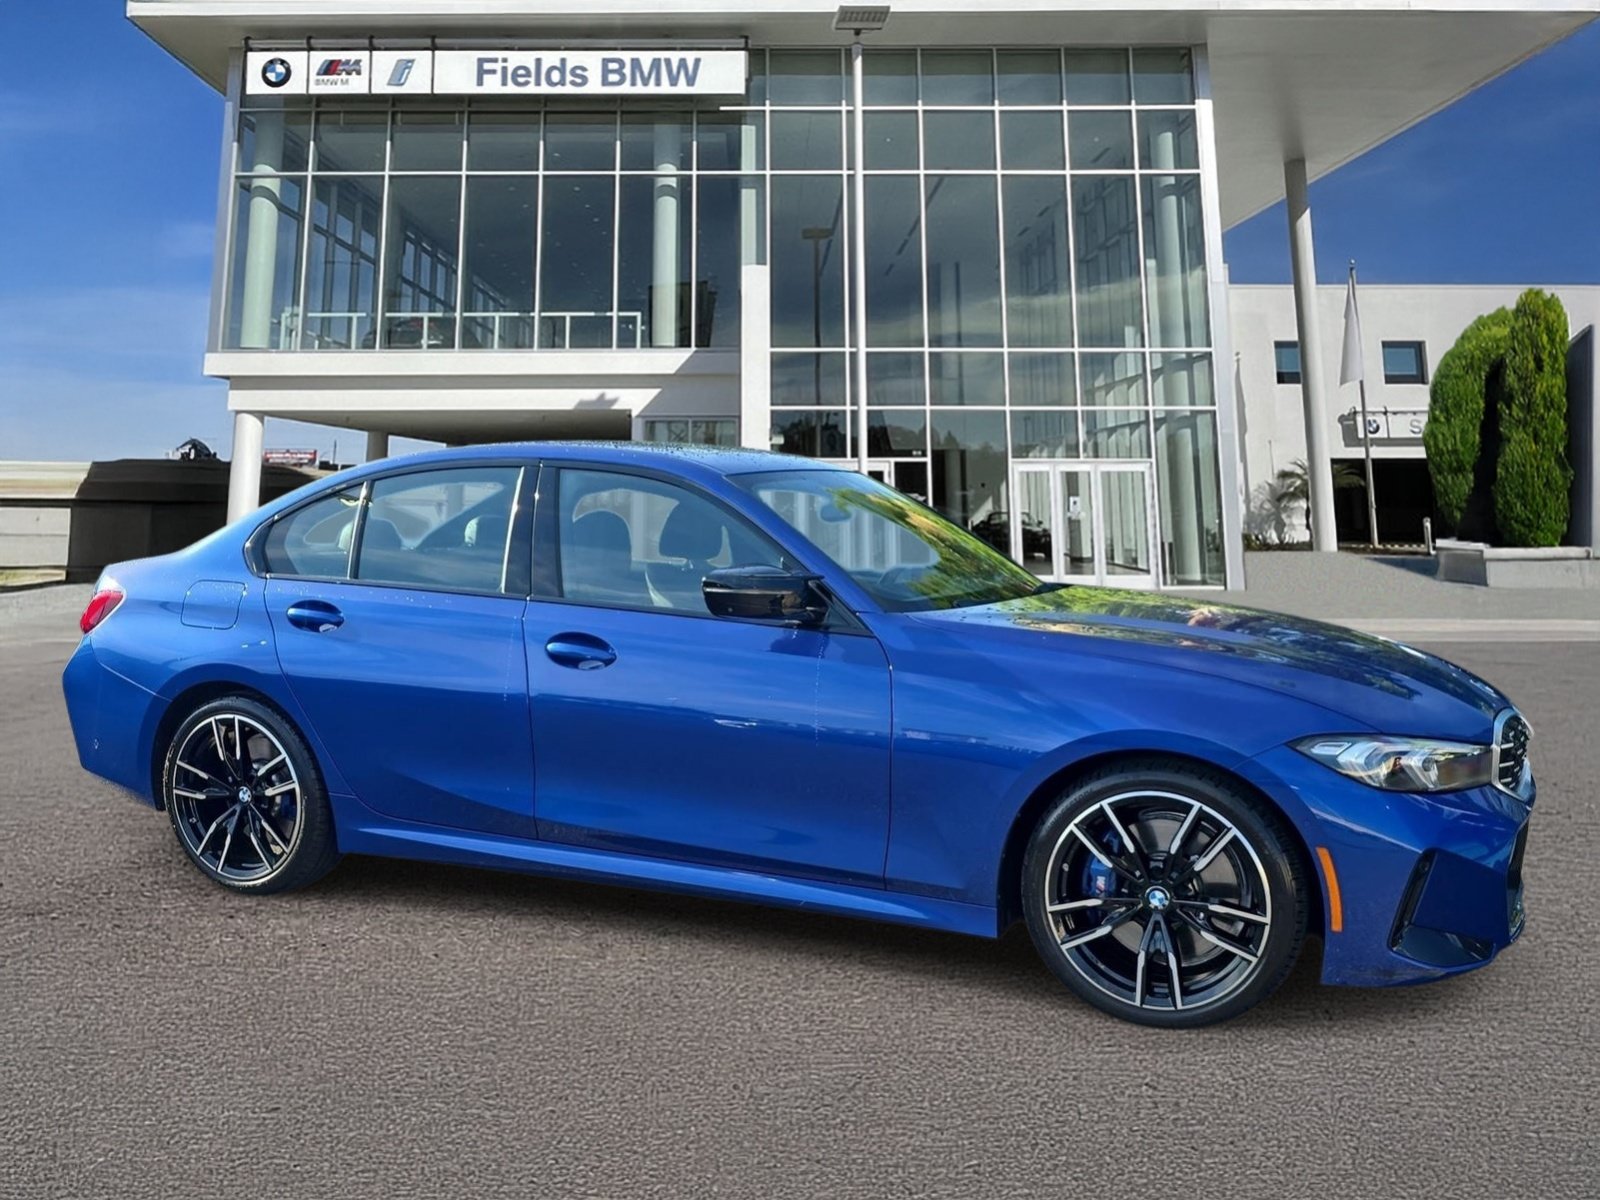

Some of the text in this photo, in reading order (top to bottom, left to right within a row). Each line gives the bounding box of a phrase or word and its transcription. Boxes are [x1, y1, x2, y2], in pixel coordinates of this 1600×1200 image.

[315, 78, 339, 86] BMW
[475, 57, 702, 88] Fields BMW
